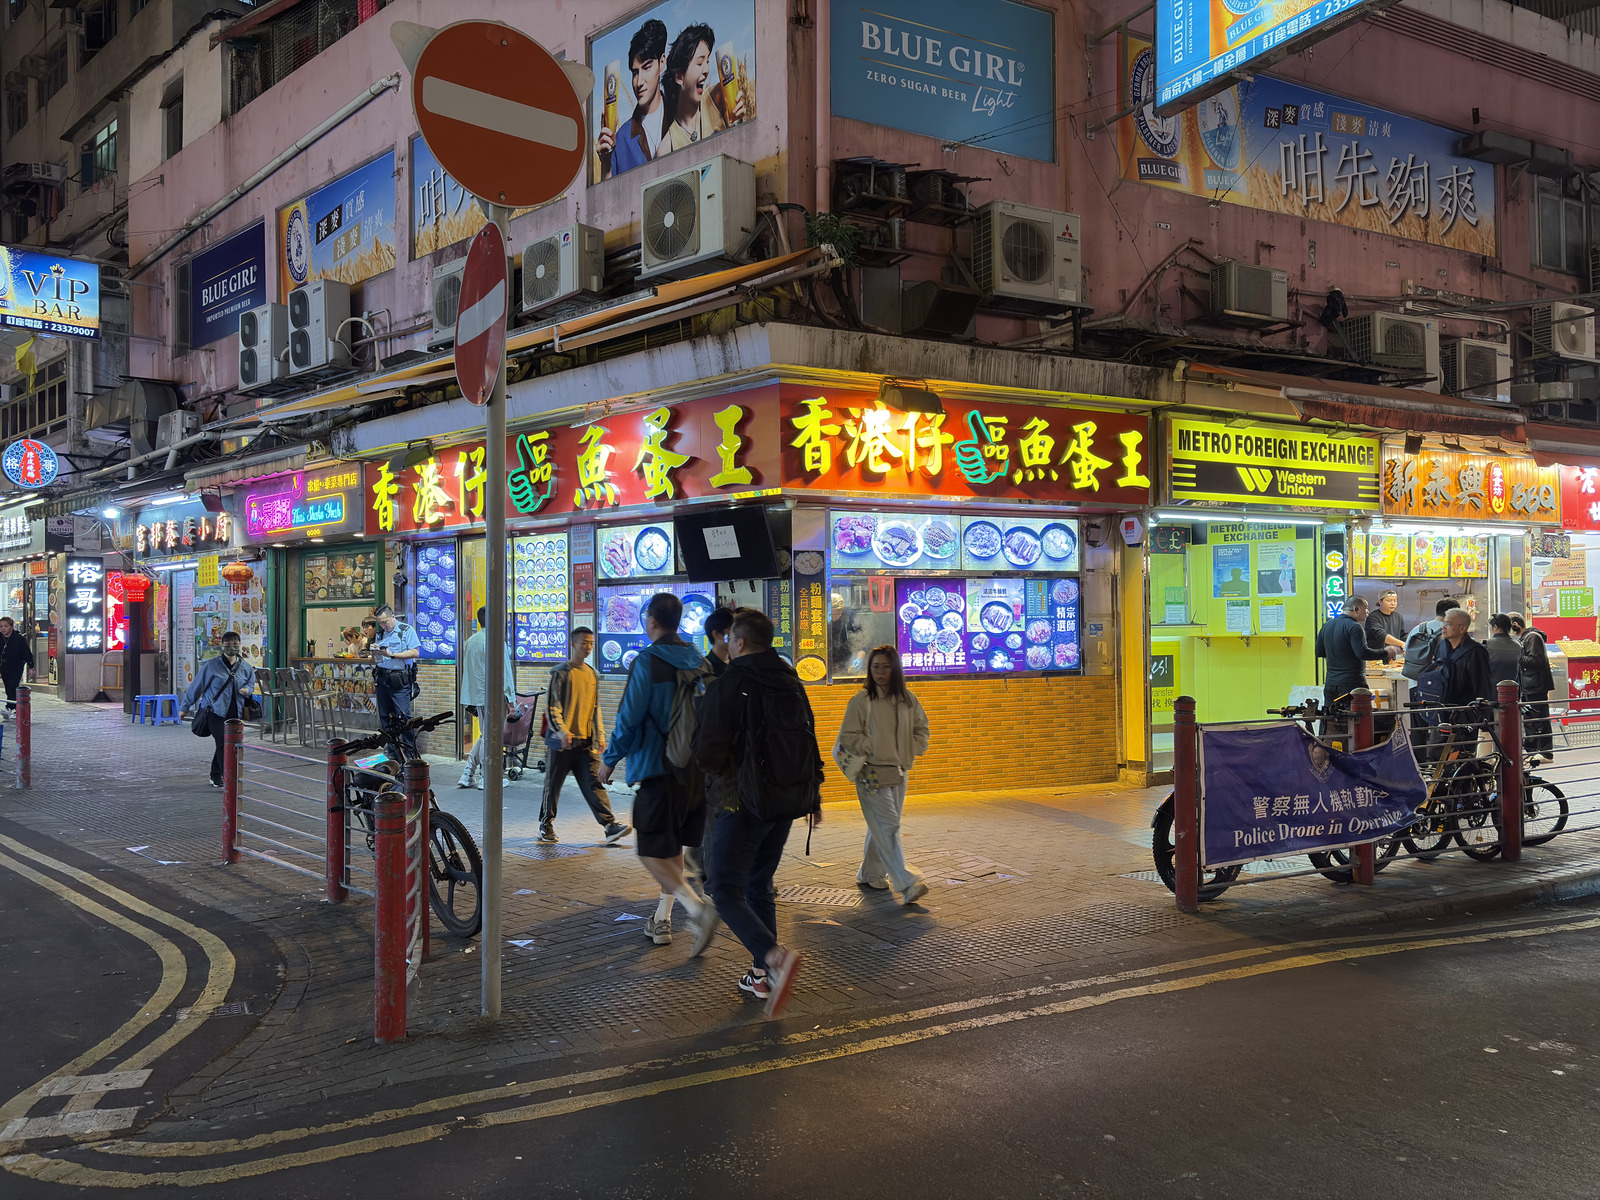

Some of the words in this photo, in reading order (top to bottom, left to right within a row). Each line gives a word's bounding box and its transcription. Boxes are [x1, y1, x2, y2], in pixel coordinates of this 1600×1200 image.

[1174, 0, 1183, 19] GI
[1174, 21, 1183, 64] BLUE
[1229, 17, 1254, 40] BLUE
[861, 21, 943, 67] BLUE
[949, 46, 1022, 87] GIRL
[866, 70, 897, 85] ZERO
[901, 78, 937, 96] SUGAR
[941, 88, 967, 102] BEER
[971, 86, 1019, 117] Light
[1138, 115, 1162, 150] PILSENER
[1140, 163, 1167, 176] BLUE
[1207, 174, 1230, 186] BLUE
[1279, 131, 1479, 237] 咁先夠爽
[20, 269, 89, 303] VIP
[202, 281, 229, 307] BLUE
[229, 266, 257, 293] GIRL
[32, 299, 82, 321] BAR
[224, 302, 241, 316] PREMIUM
[241, 298, 251, 309] BEER
[573, 404, 753, 508] 魚蛋王
[1013, 416, 1151, 492] 魚蛋王
[1178, 429, 1232, 455] METRO
[1235, 434, 1298, 460] FOREIGN
[1301, 441, 1375, 466] EXCHANGE
[1276, 469, 1326, 486] Western
[1277, 482, 1315, 496] Union
[1510, 482, 1557, 514] BBQ
[1210, 523, 1245, 534] METRO
[1223, 531, 1279, 542] EXCHANGE
[810, 582, 823, 636] 粉麵套餐
[901, 651, 967, 668] 香港仔魚蛋王
[1234, 828, 1276, 848] Police
[1277, 822, 1325, 841] Drone
[1328, 819, 1342, 835] in
